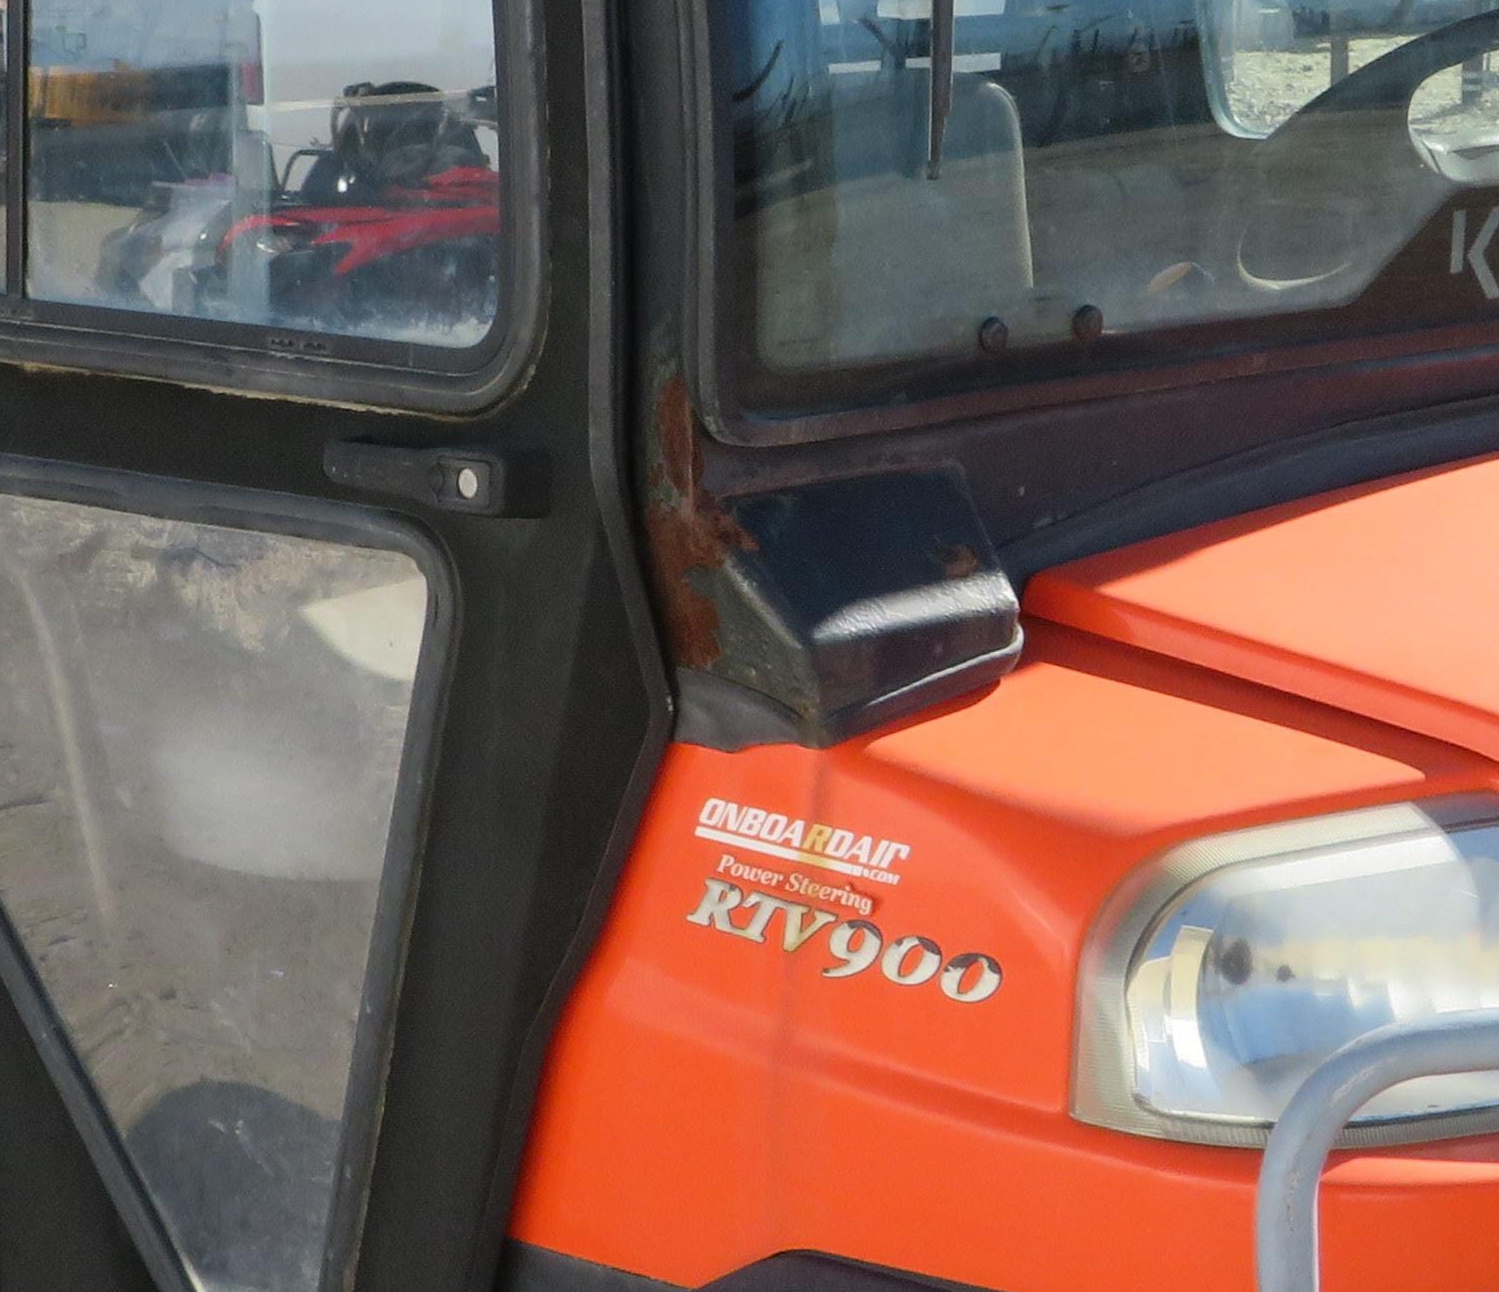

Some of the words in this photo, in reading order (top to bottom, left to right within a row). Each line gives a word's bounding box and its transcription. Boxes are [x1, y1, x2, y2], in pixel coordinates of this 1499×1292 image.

[717, 854, 784, 887] Power
[784, 872, 874, 916] Steering
[686, 876, 1005, 1005] RTV900
